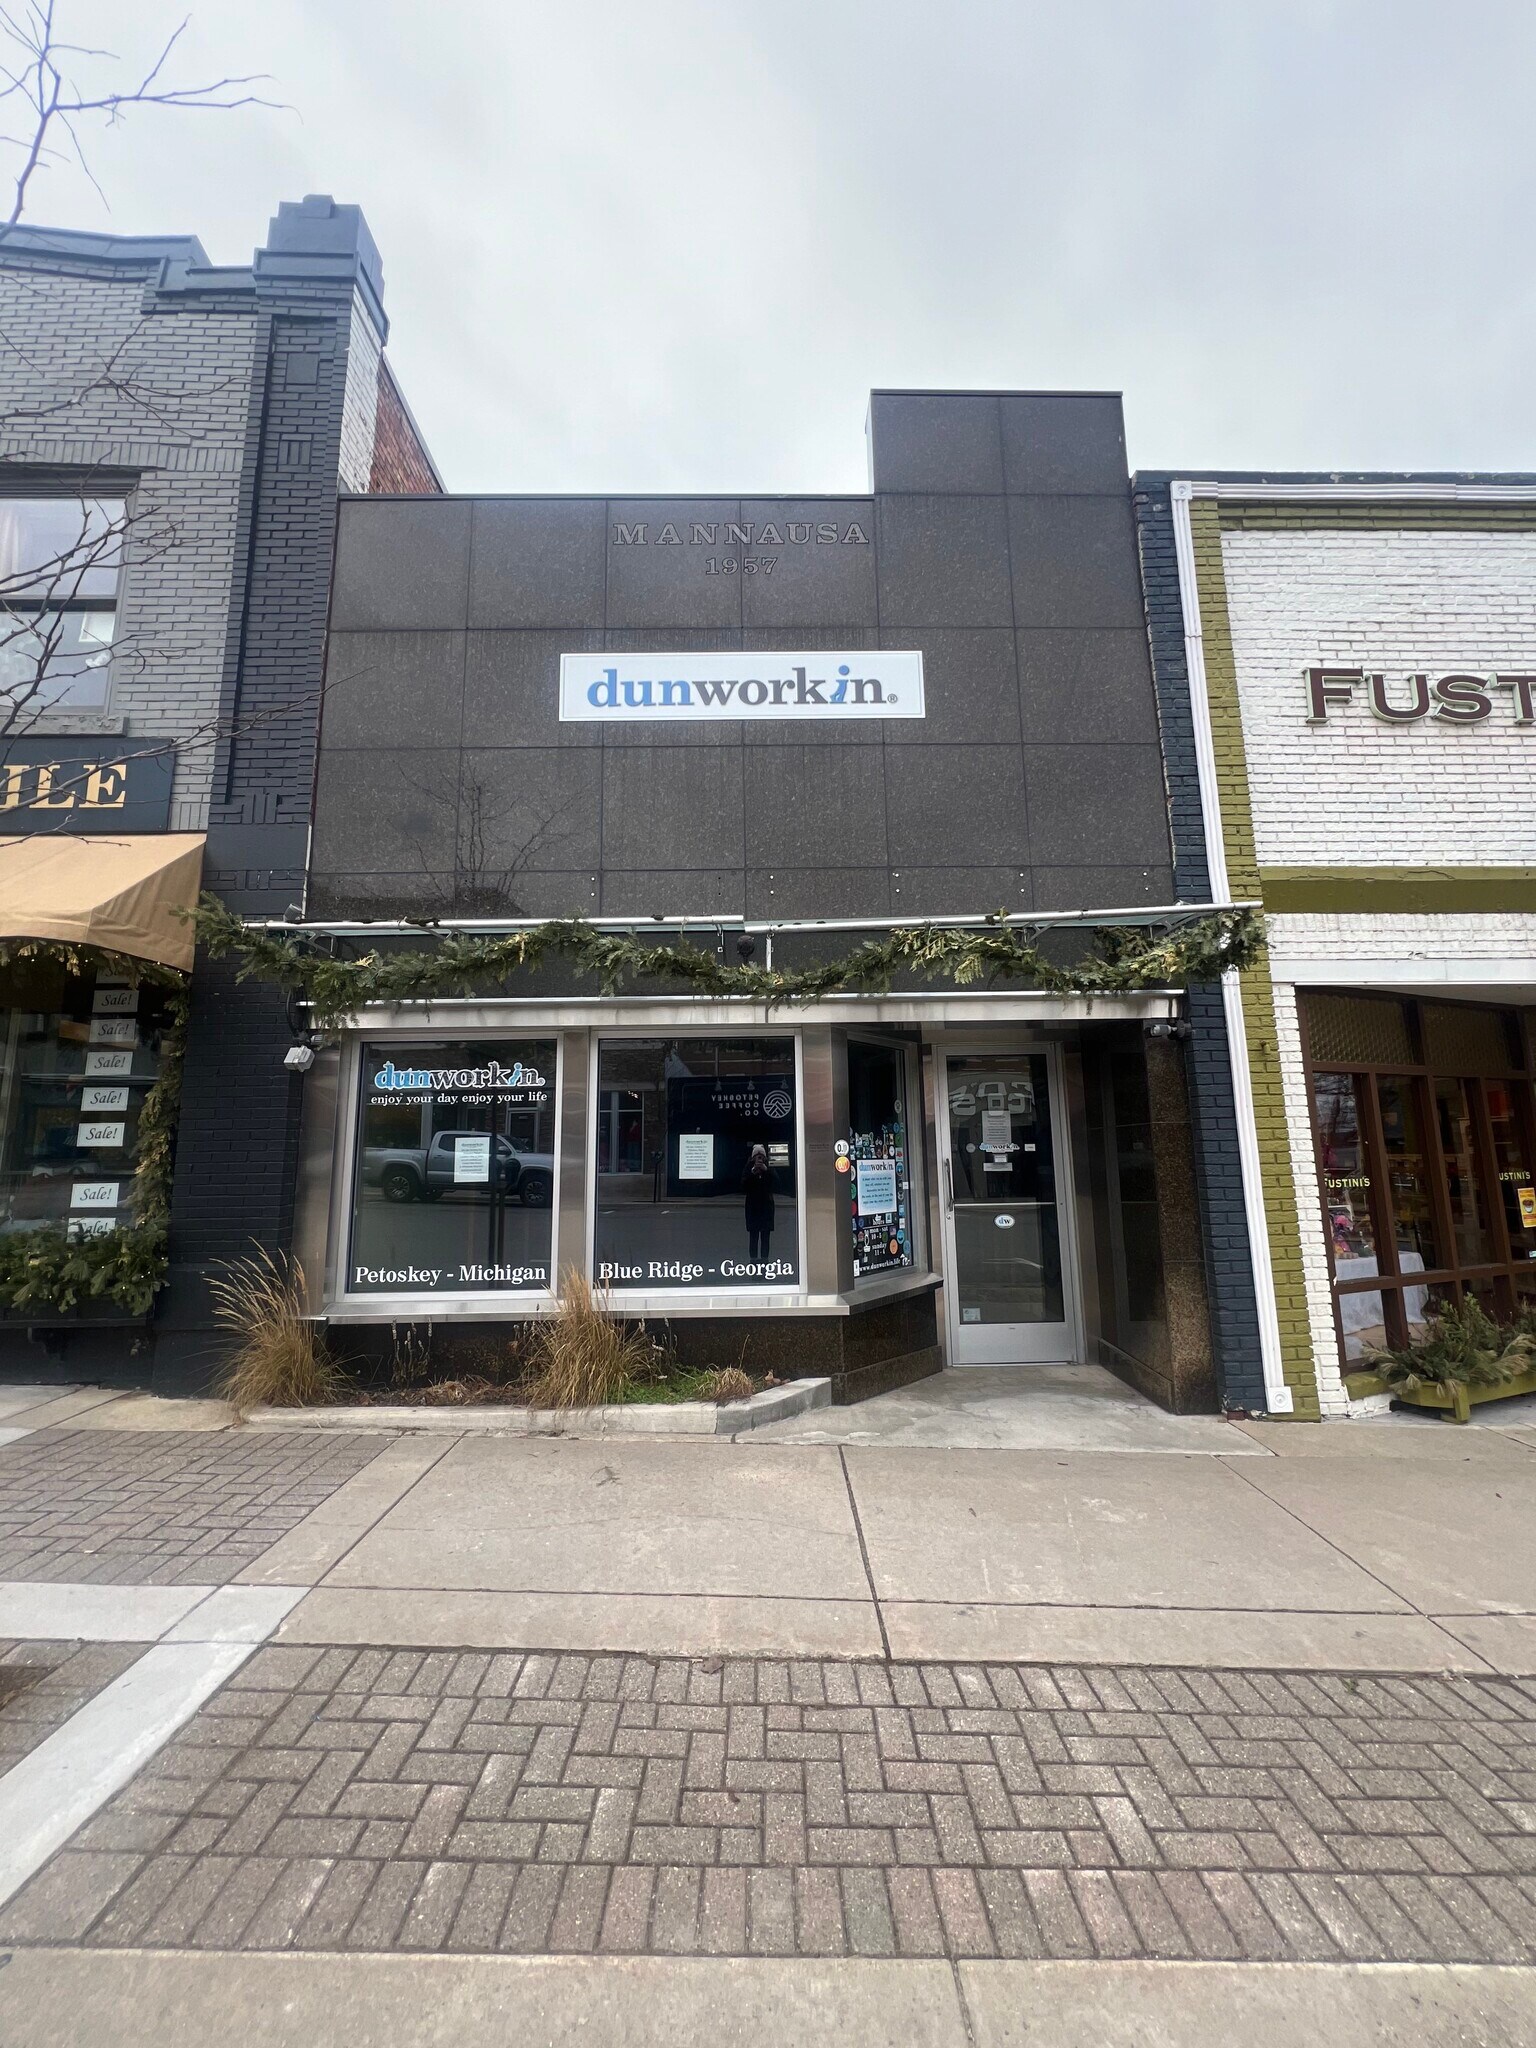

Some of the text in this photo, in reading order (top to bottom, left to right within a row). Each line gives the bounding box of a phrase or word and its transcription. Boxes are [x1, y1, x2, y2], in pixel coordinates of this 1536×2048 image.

[612, 522, 870, 545] MANNAUSA
[705, 557, 778, 575] 1957
[101, 992, 132, 1007] Sale!
[98, 1023, 129, 1036] Sale!
[94, 1055, 126, 1069] Sale!
[90, 1090, 122, 1105] Sale!
[371, 1095, 402, 1107] enjoy
[406, 1095, 433, 1106] your
[462, 1093, 496, 1105] enjoy
[497, 1094, 525, 1104] your
[528, 1092, 548, 1102] life
[85, 1126, 118, 1140] Sale!
[80, 1187, 112, 1201] Sale!
[354, 1266, 442, 1286] Petoskey
[458, 1264, 547, 1285] Michigan
[598, 1262, 643, 1279] Blue
[647, 1261, 704, 1281] Ridge
[720, 1259, 794, 1280] Georgia
